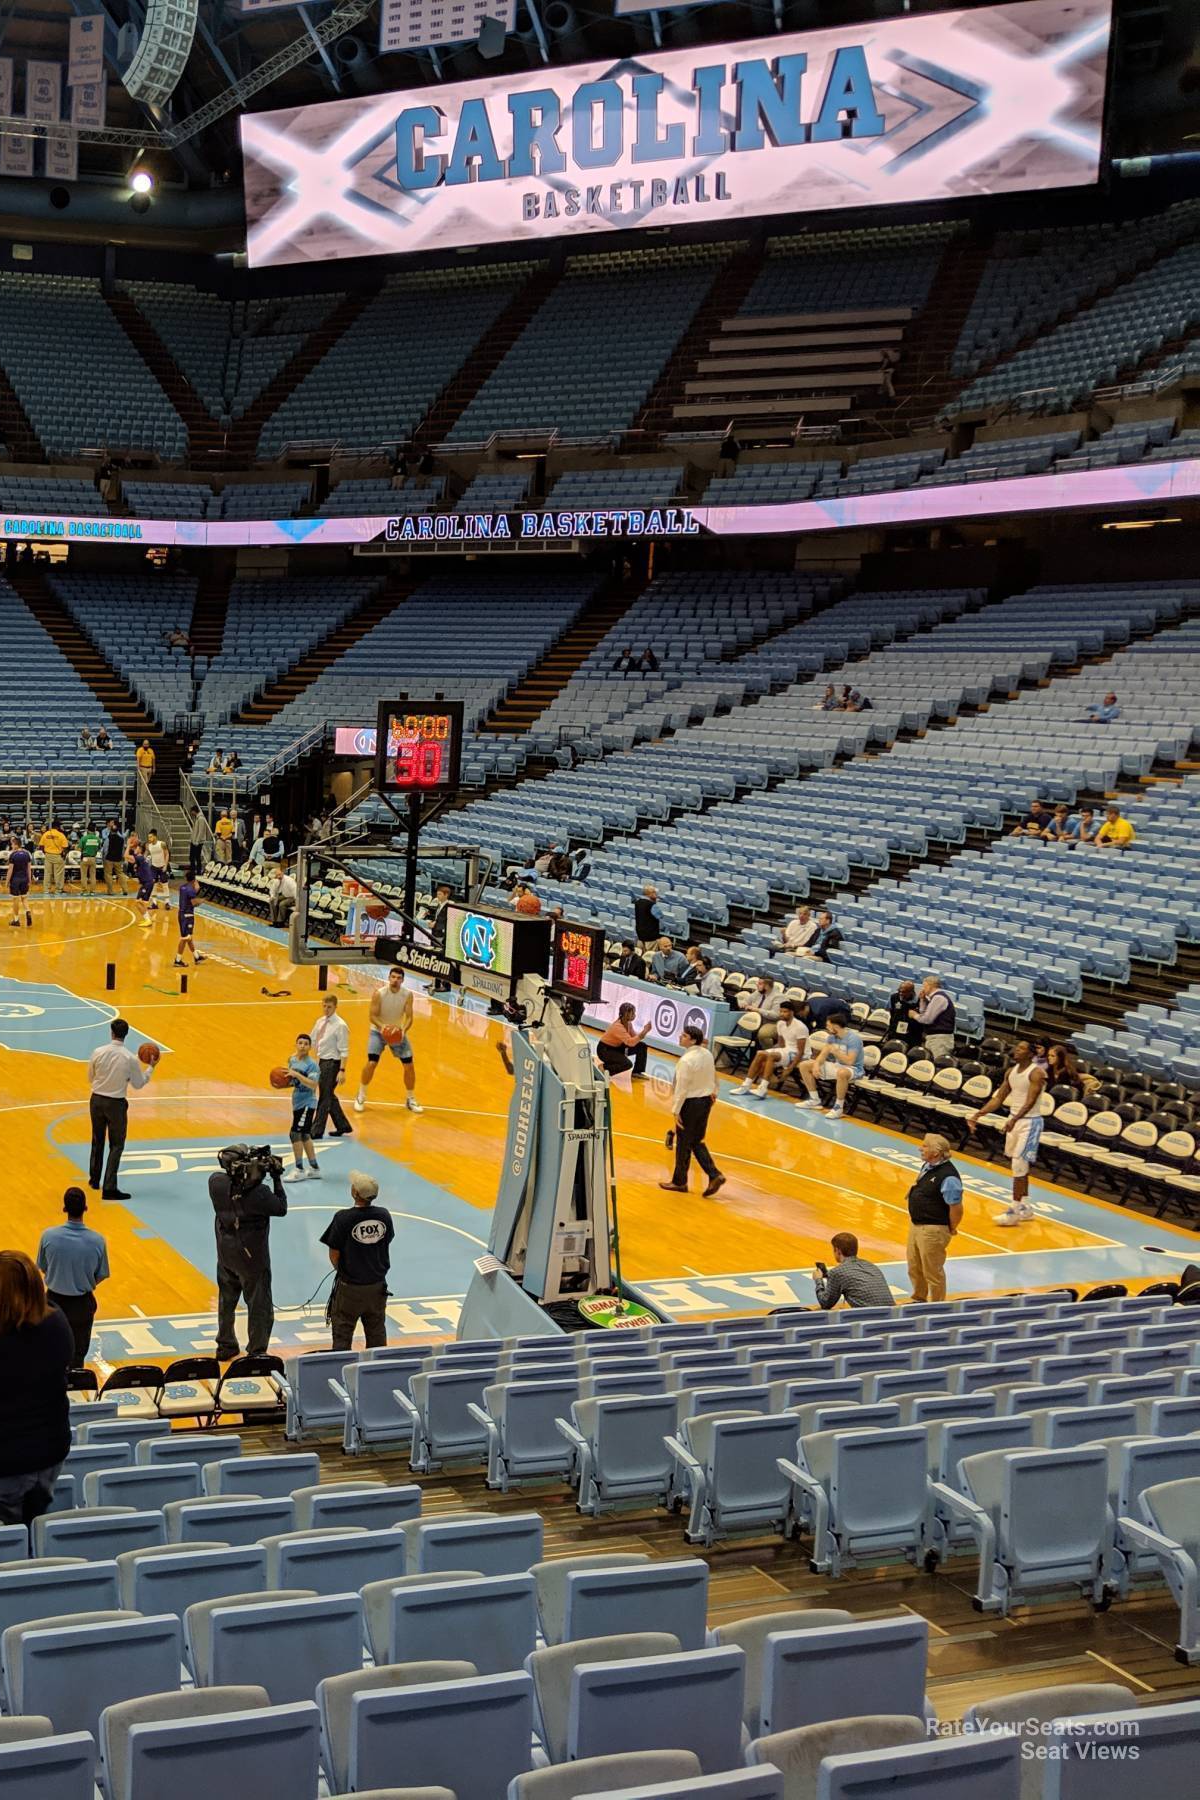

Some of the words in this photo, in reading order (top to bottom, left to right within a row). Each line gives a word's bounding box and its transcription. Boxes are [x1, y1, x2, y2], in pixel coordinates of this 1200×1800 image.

[396, 45, 885, 190] CAROLINA
[522, 171, 732, 221] BASKETBALL
[4, 519, 65, 536] CAROLINA
[69, 522, 143, 539] BASKETBALL
[385, 514, 511, 541] CAROLINA
[521, 509, 701, 538] BASKETBALL
[396, 743, 441, 782] 30
[472, 975, 503, 997] SPALDING
[568, 956, 587, 986] 30
[512, 1058, 536, 1177] @GOHEELS
[360, 1224, 380, 1236] FOX
